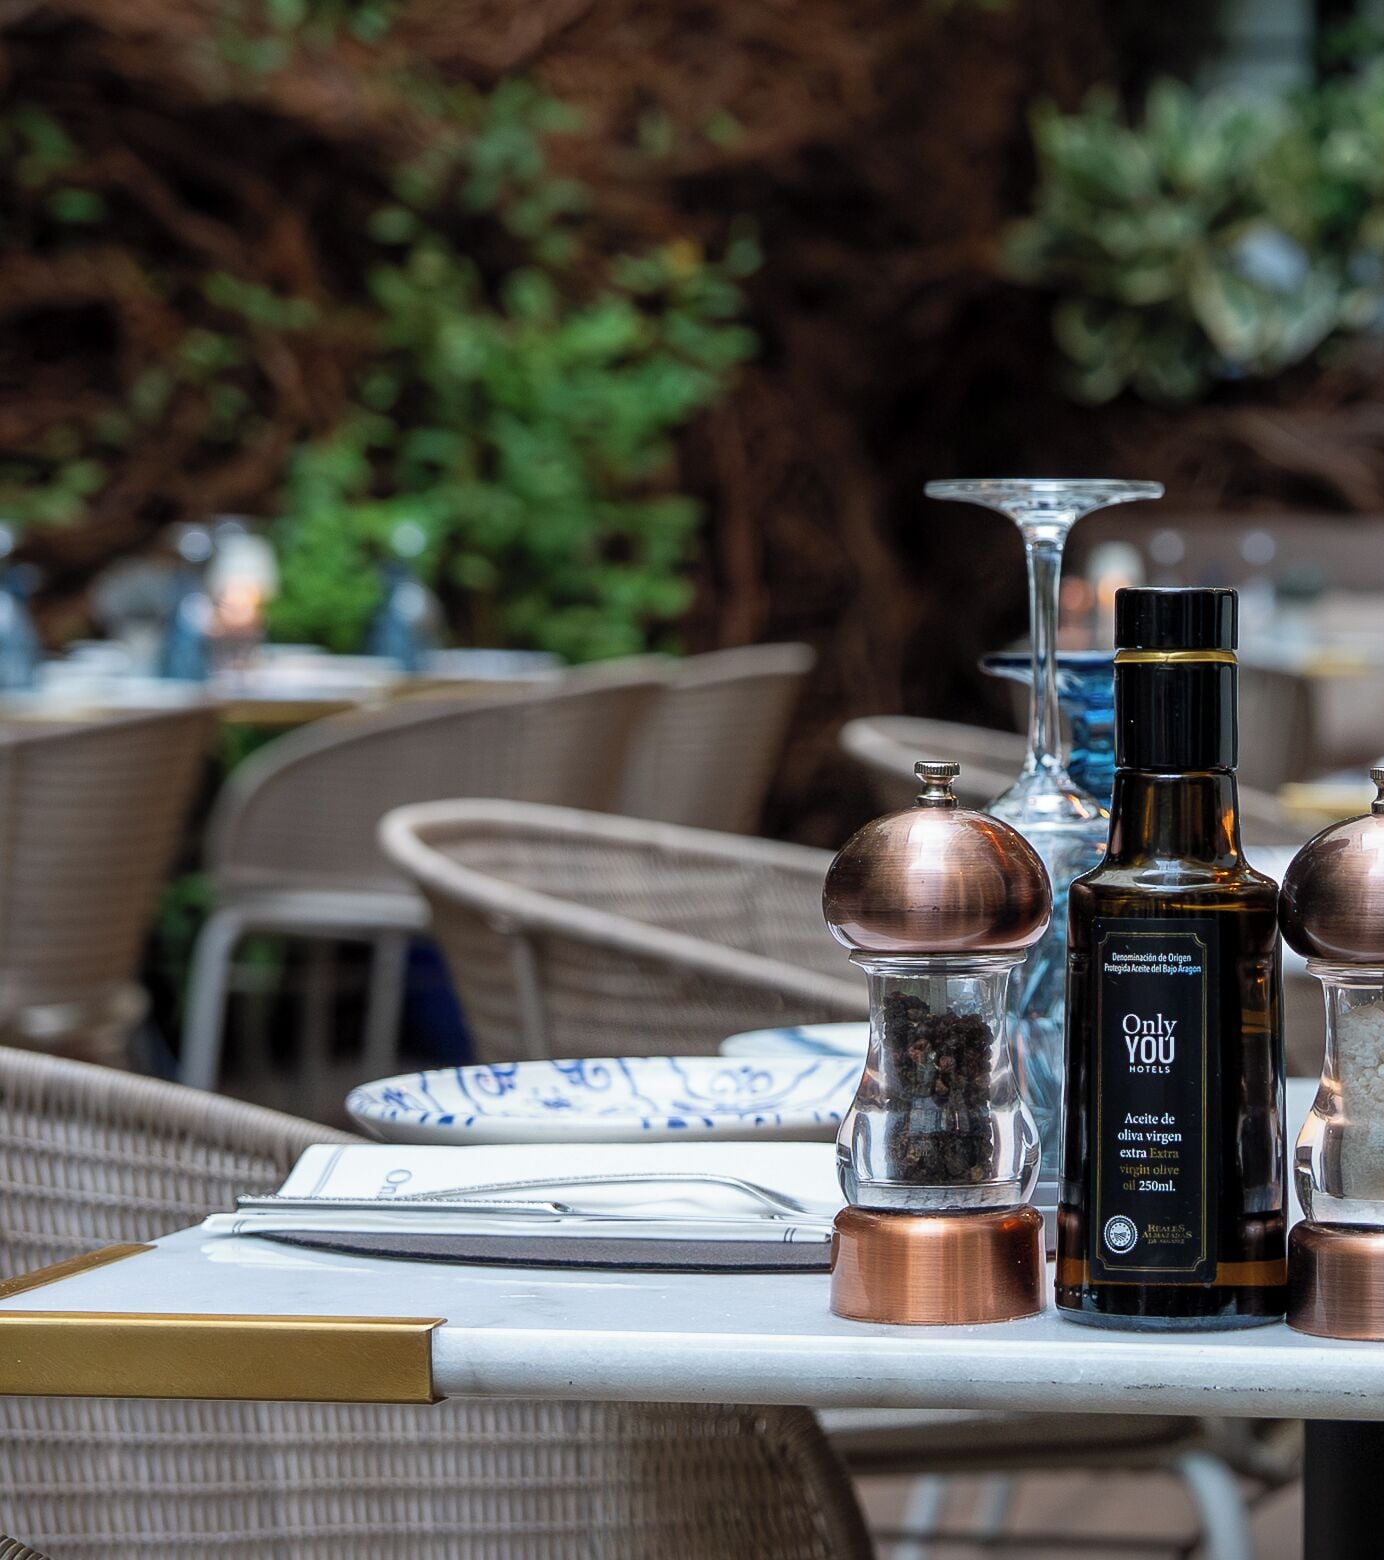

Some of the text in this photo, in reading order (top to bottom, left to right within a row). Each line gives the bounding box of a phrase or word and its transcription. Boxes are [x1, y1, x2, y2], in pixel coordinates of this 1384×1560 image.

[1112, 952, 1192, 964] Denominación de Origen
[1104, 962, 1130, 974] Protegida
[1131, 963, 1151, 972] Aceite
[1151, 963, 1162, 972] del
[1162, 963, 1177, 975] Bajo
[1122, 1013, 1177, 1041] Only
[1124, 1035, 1175, 1064] YOU
[1129, 1065, 1171, 1074] HOTELS
[1124, 1113, 1175, 1125] Aceite de
[1118, 1129, 1182, 1145] oliva virgen
[1120, 1147, 1179, 1158] extra Extra
[1119, 1163, 1179, 1177] virgin olive
[1123, 1179, 1176, 1191] oil 250ml.
